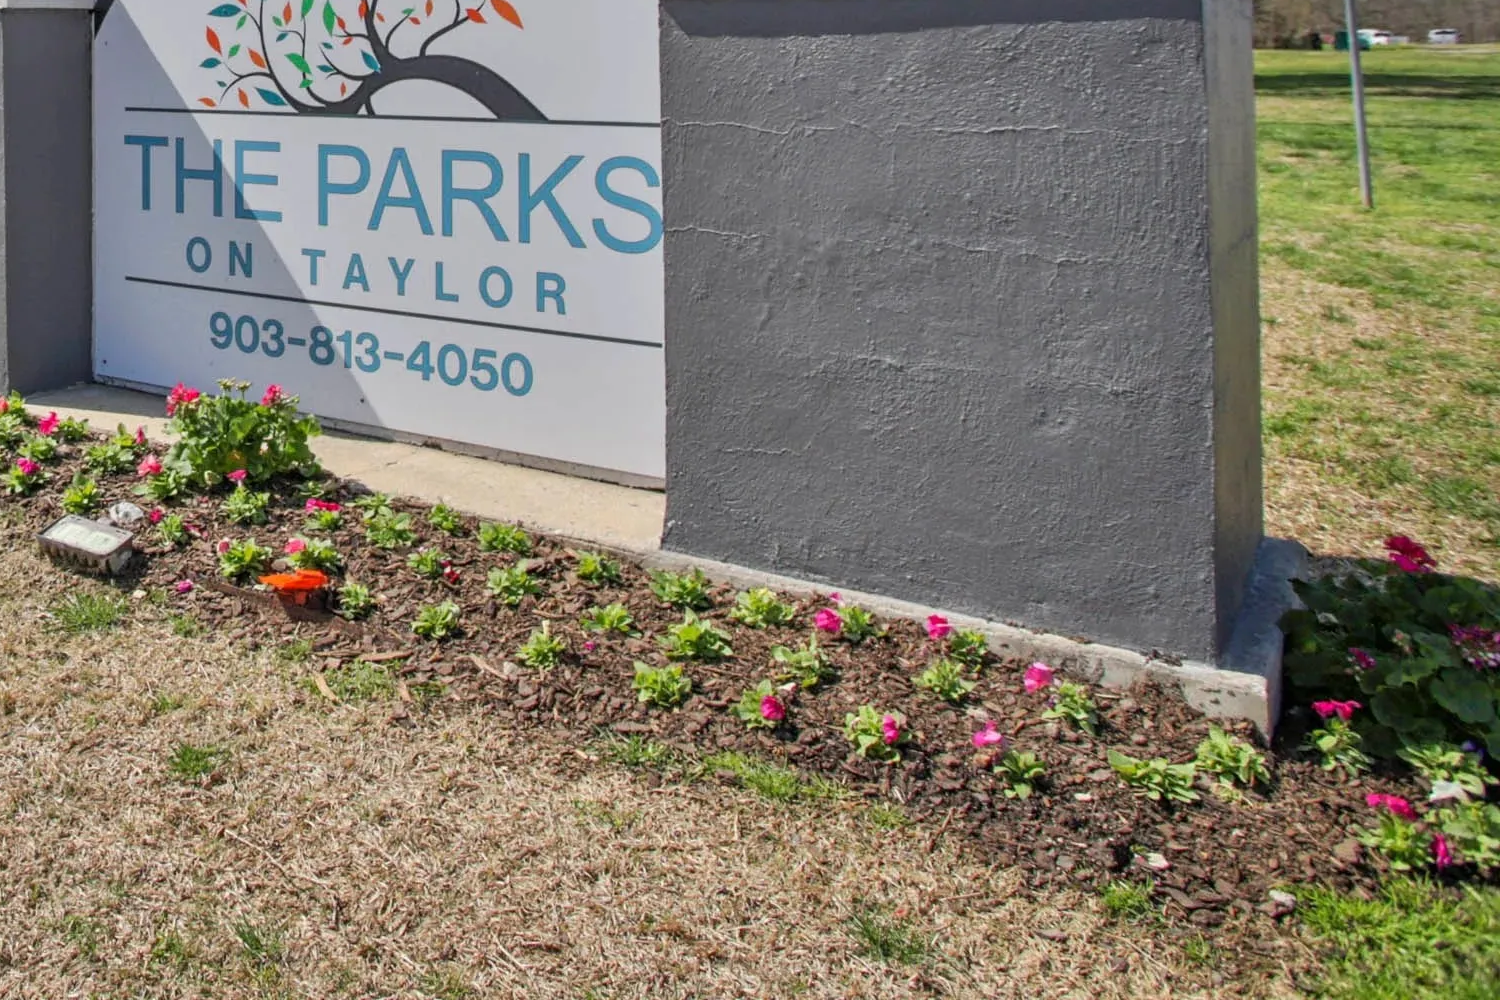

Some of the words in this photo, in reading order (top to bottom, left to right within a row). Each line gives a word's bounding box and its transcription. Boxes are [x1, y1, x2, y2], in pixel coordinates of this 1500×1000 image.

[123, 134, 283, 222] THE
[317, 144, 664, 254] PARKS
[185, 236, 254, 279] ON
[301, 248, 567, 315] TAYLOR
[209, 311, 534, 397] 903-813-4050
